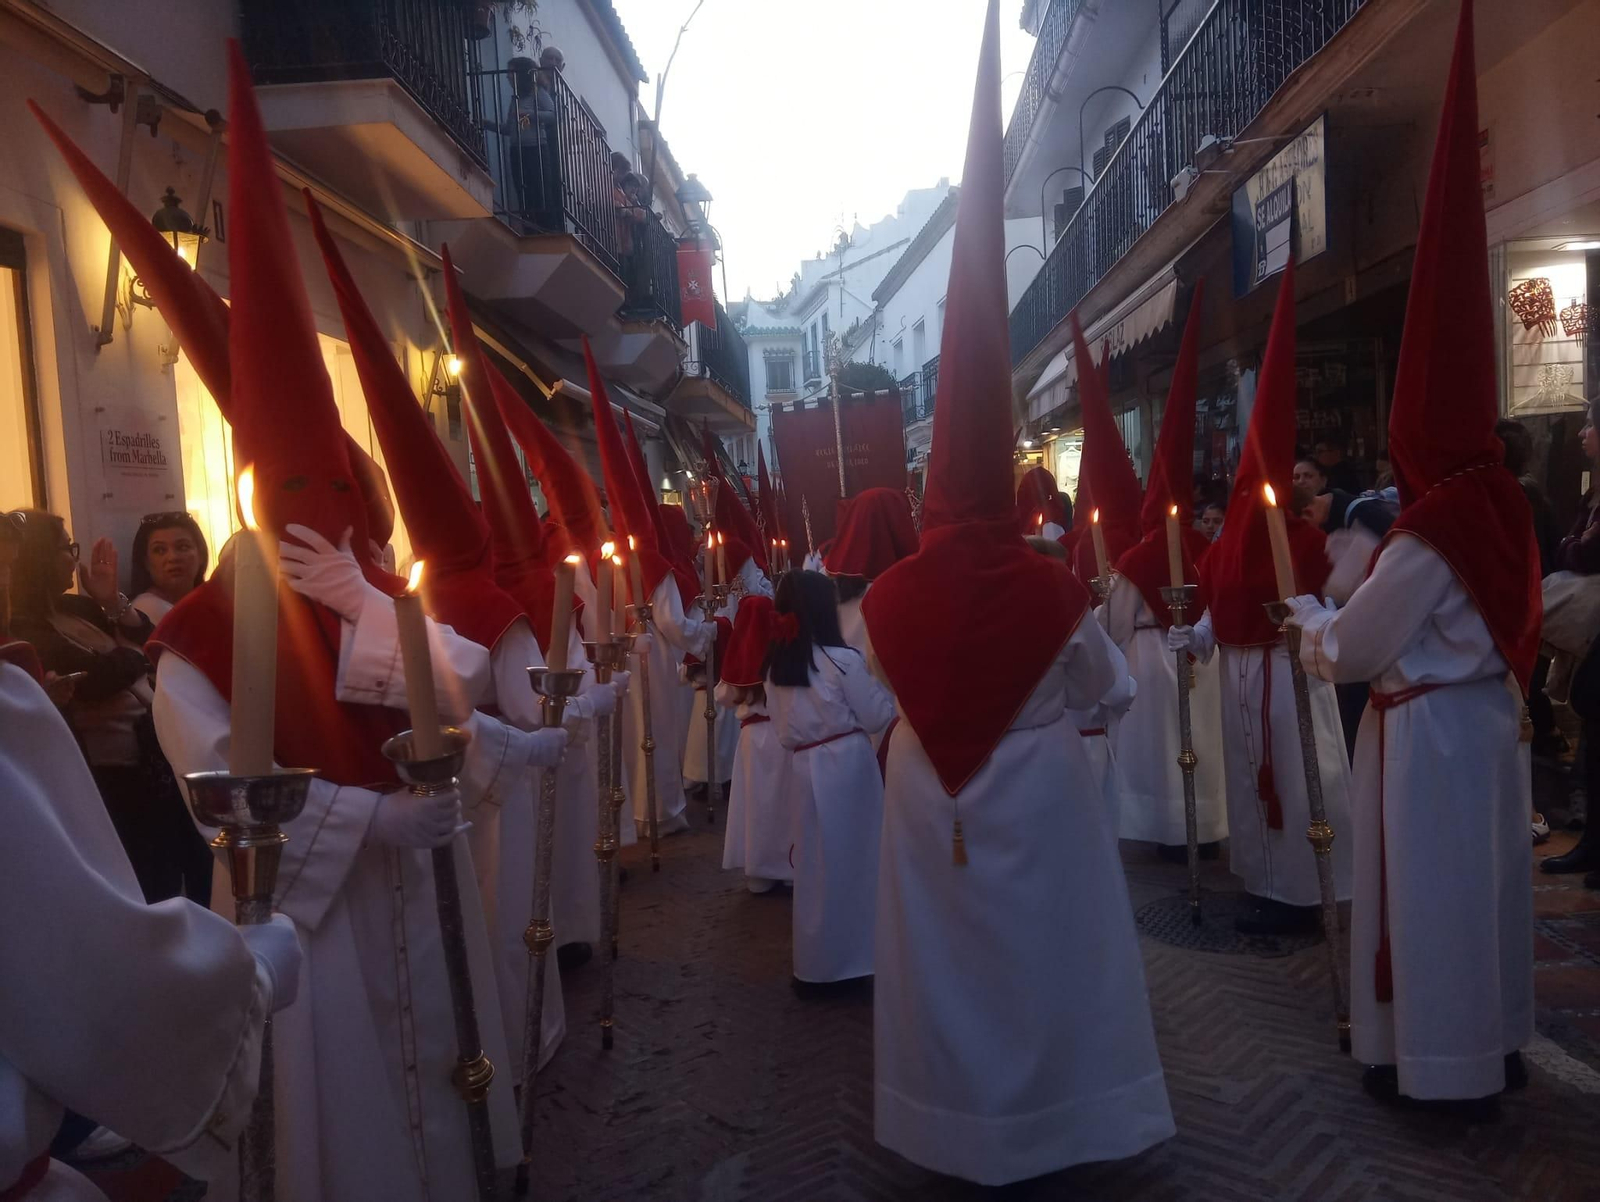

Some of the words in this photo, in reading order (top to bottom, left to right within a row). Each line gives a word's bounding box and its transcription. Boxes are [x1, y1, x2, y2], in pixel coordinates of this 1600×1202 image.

[1257, 203, 1266, 232] SE
[1266, 184, 1293, 226] ALQUILA
[108, 430, 114, 445] 2
[115, 431, 160, 449] Espadrilles
[110, 447, 131, 463] from
[132, 449, 167, 466] Marbella
